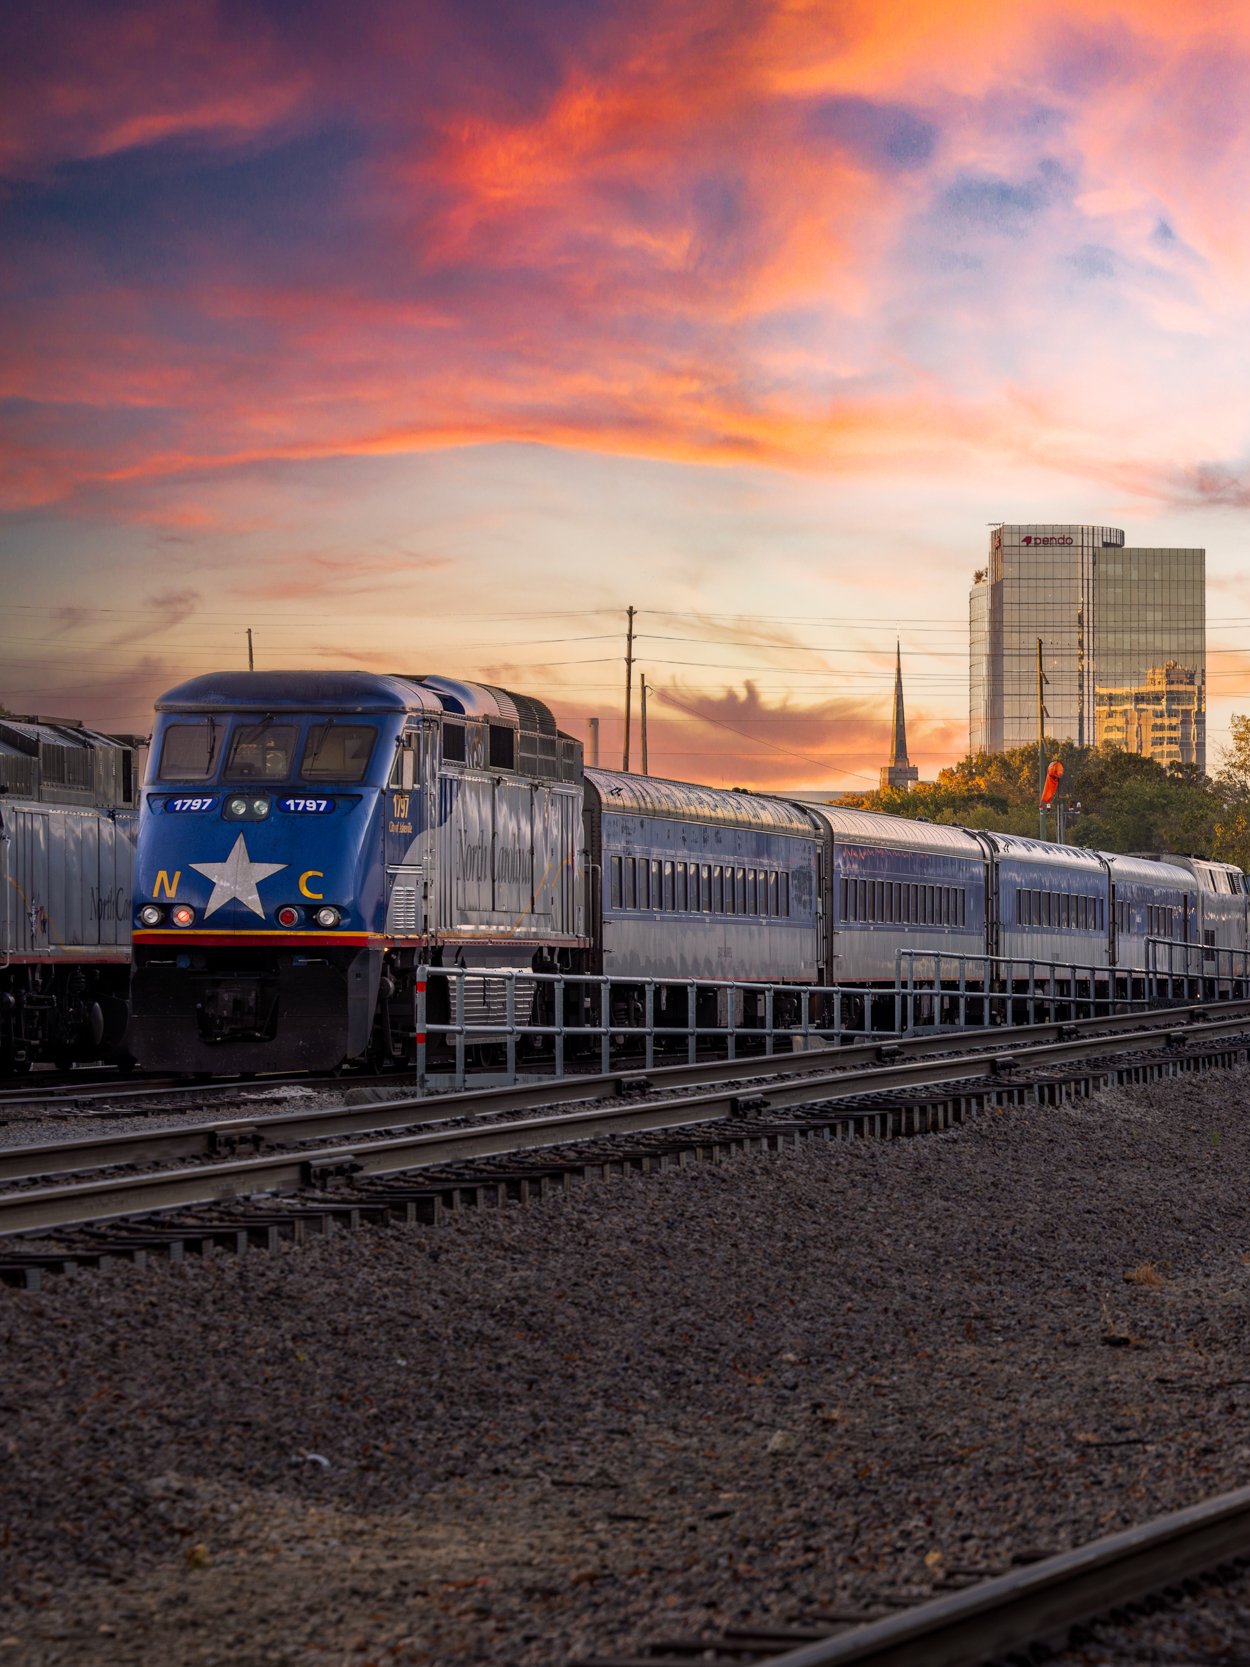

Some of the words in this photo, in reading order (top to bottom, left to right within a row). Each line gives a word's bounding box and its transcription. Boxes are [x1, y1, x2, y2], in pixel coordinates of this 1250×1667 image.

[1034, 534, 1074, 546] pendo
[173, 798, 213, 811] 1797
[285, 799, 328, 812] 1797
[393, 794, 409, 818] 1797
[456, 828, 488, 883] North
[152, 870, 182, 899] N
[297, 870, 324, 900] C
[89, 886, 115, 921] North
